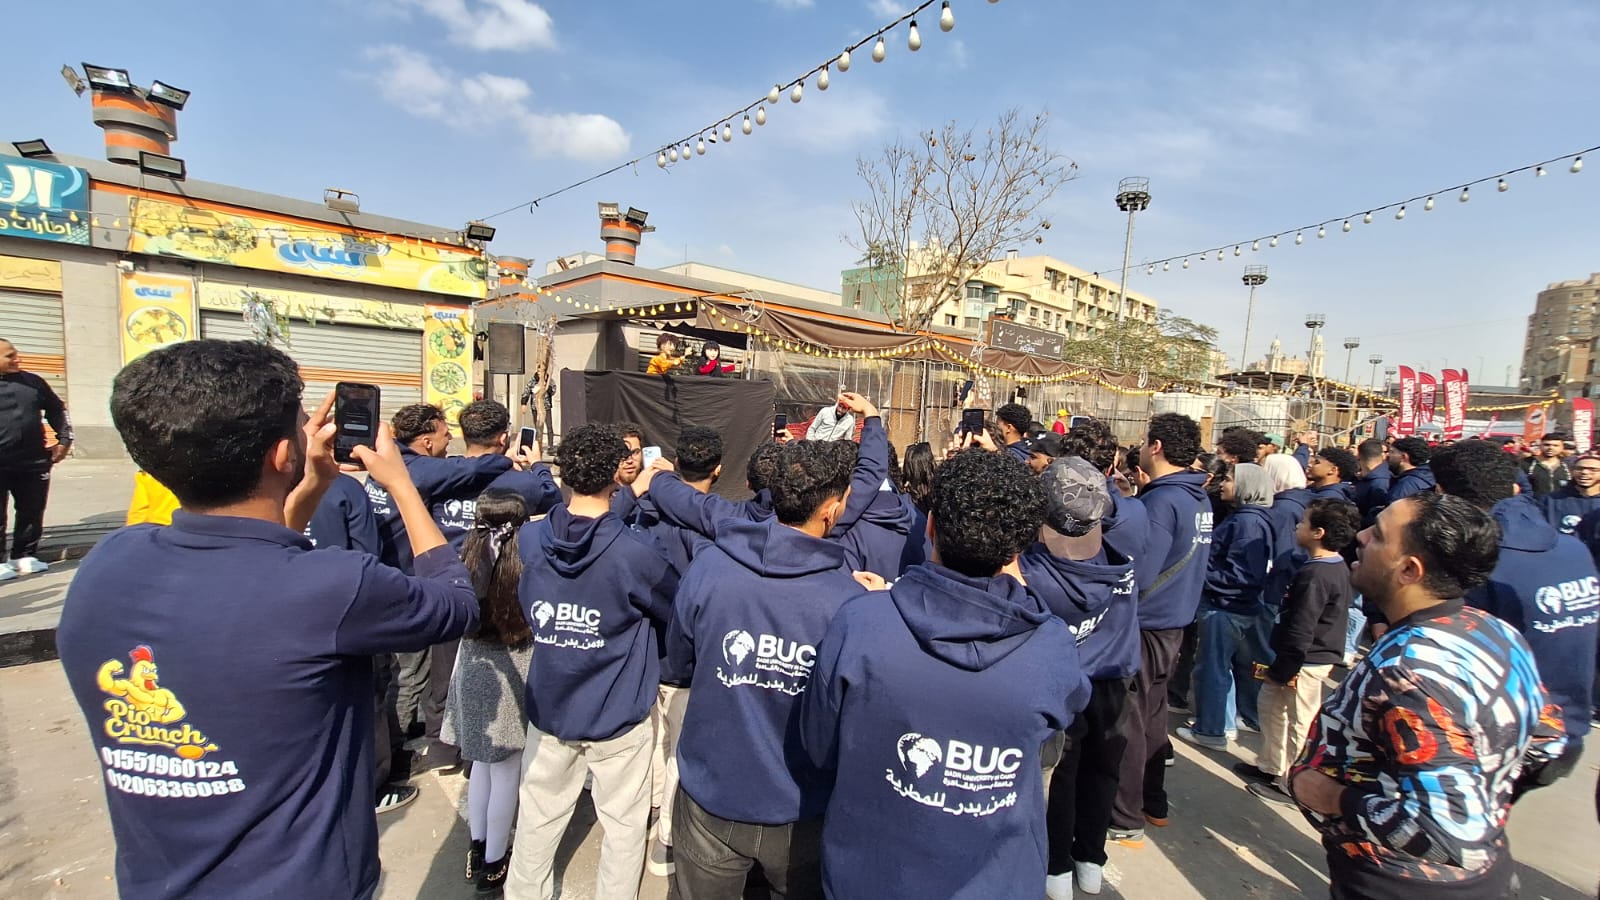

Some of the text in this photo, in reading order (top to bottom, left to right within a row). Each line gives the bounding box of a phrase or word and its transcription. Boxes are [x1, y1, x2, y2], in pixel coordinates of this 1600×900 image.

[1558, 576, 1600, 601] BUC
[556, 602, 601, 627] BUC
[757, 633, 817, 668] BUC
[103, 699, 151, 726] Pio
[104, 718, 207, 745] Crunch
[101, 746, 239, 779] 01551960124
[946, 739, 1024, 774] BUC
[106, 768, 246, 798] 01206336088
